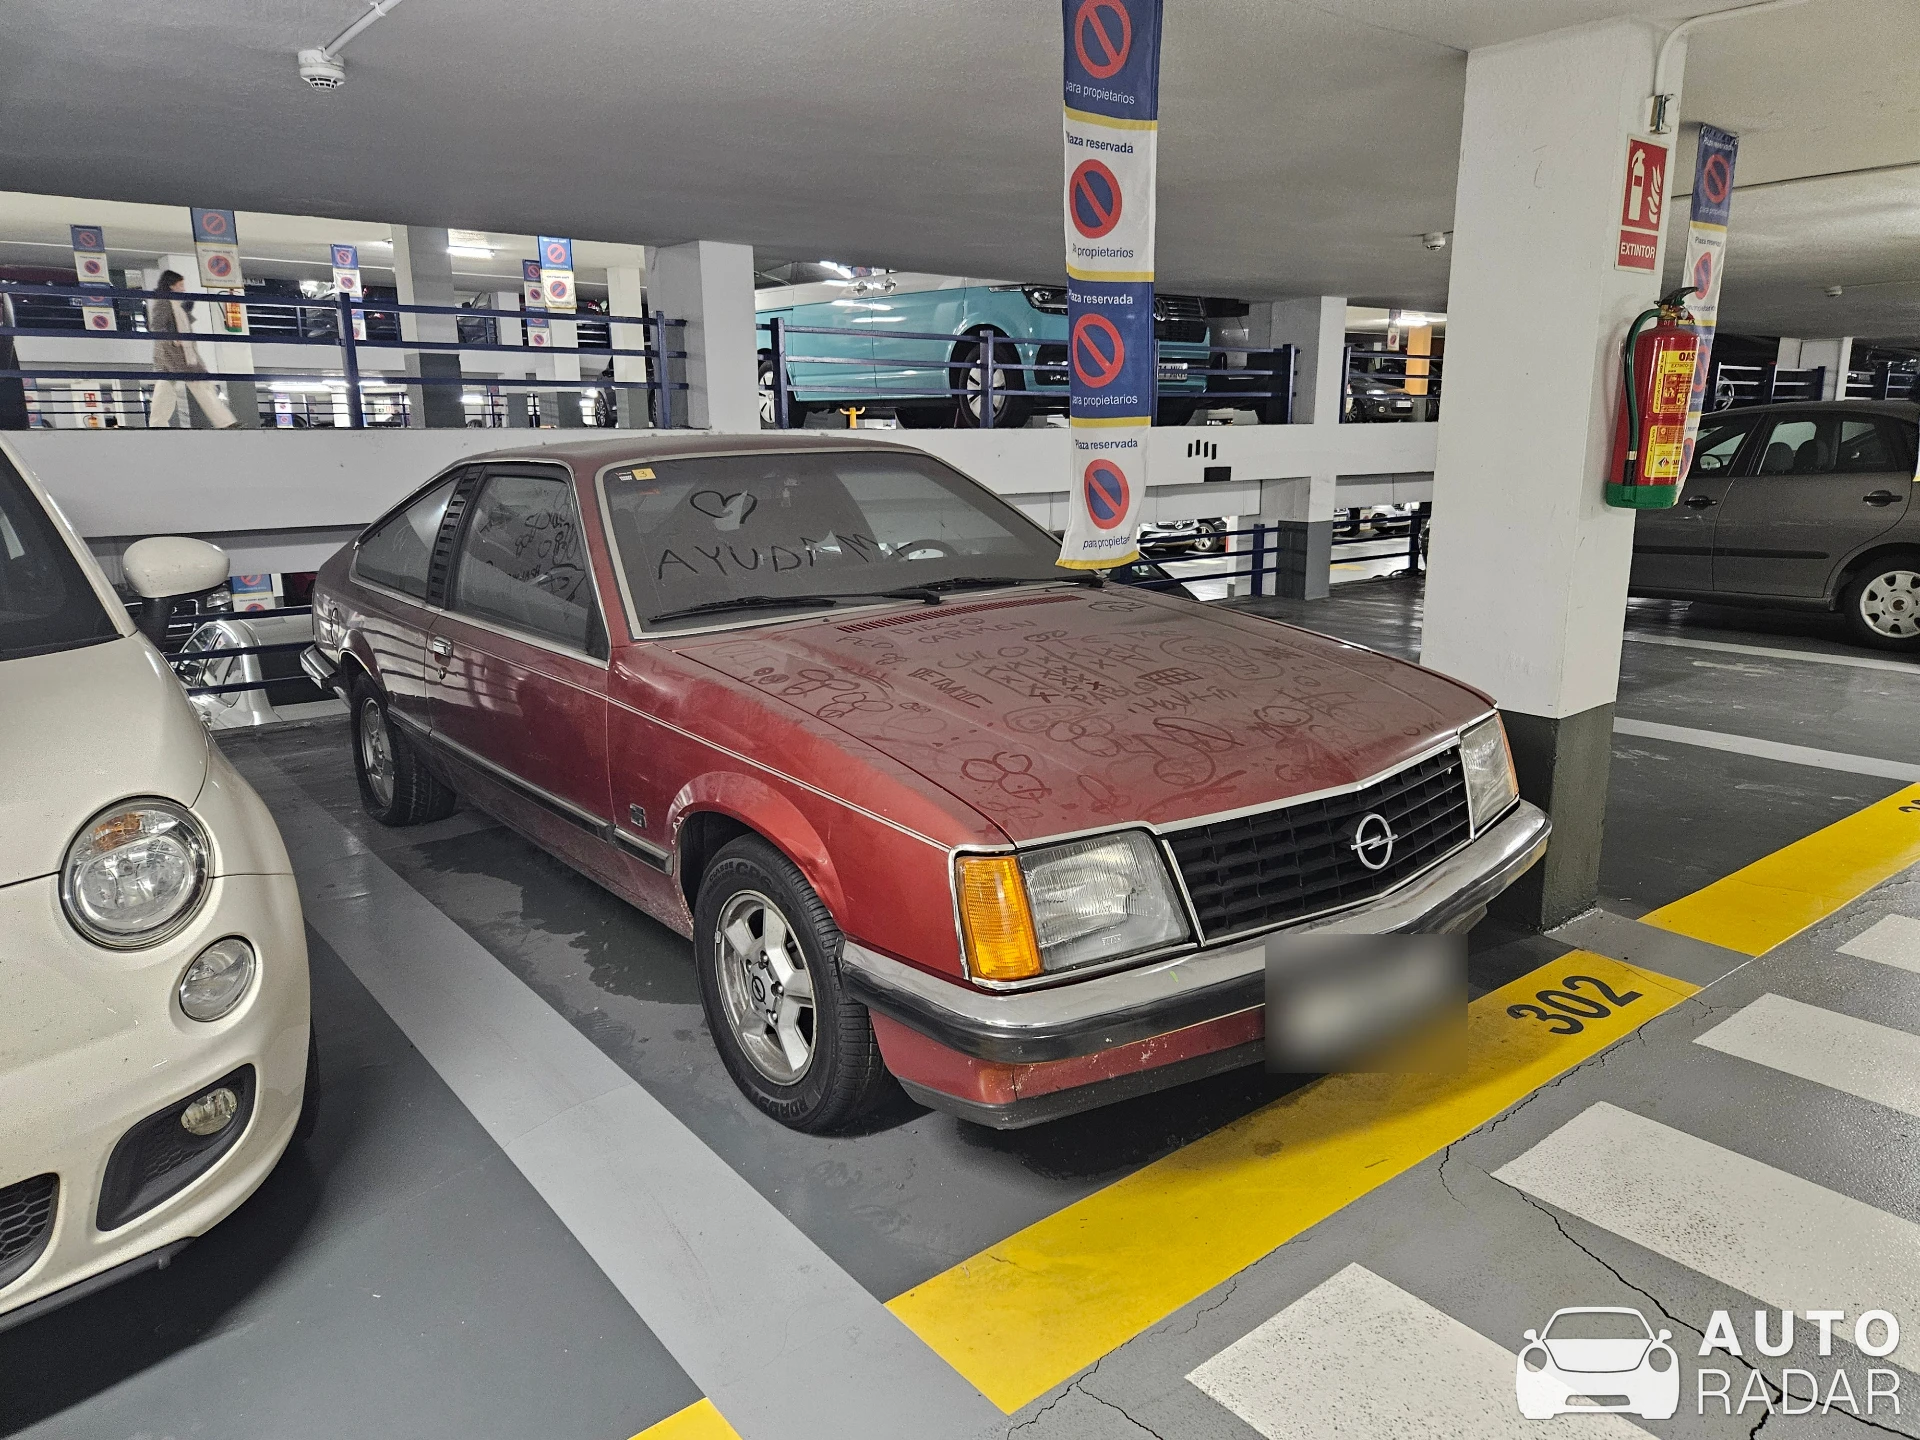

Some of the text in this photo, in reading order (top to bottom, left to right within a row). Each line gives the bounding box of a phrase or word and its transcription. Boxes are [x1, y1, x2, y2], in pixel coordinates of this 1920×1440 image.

[1083, 86, 1135, 105] propietarios
[1065, 130, 1134, 154] laza reservada
[1077, 246, 1134, 260] propietarios
[1620, 241, 1656, 260] EXTINTOR
[1068, 288, 1133, 305] Paza reservada
[1083, 394, 1138, 407] propietarios
[1090, 438, 1138, 450] reservada
[917, 620, 1038, 645] CARMEN
[1064, 680, 1159, 706] PABLO
[1506, 974, 1644, 1036] 302
